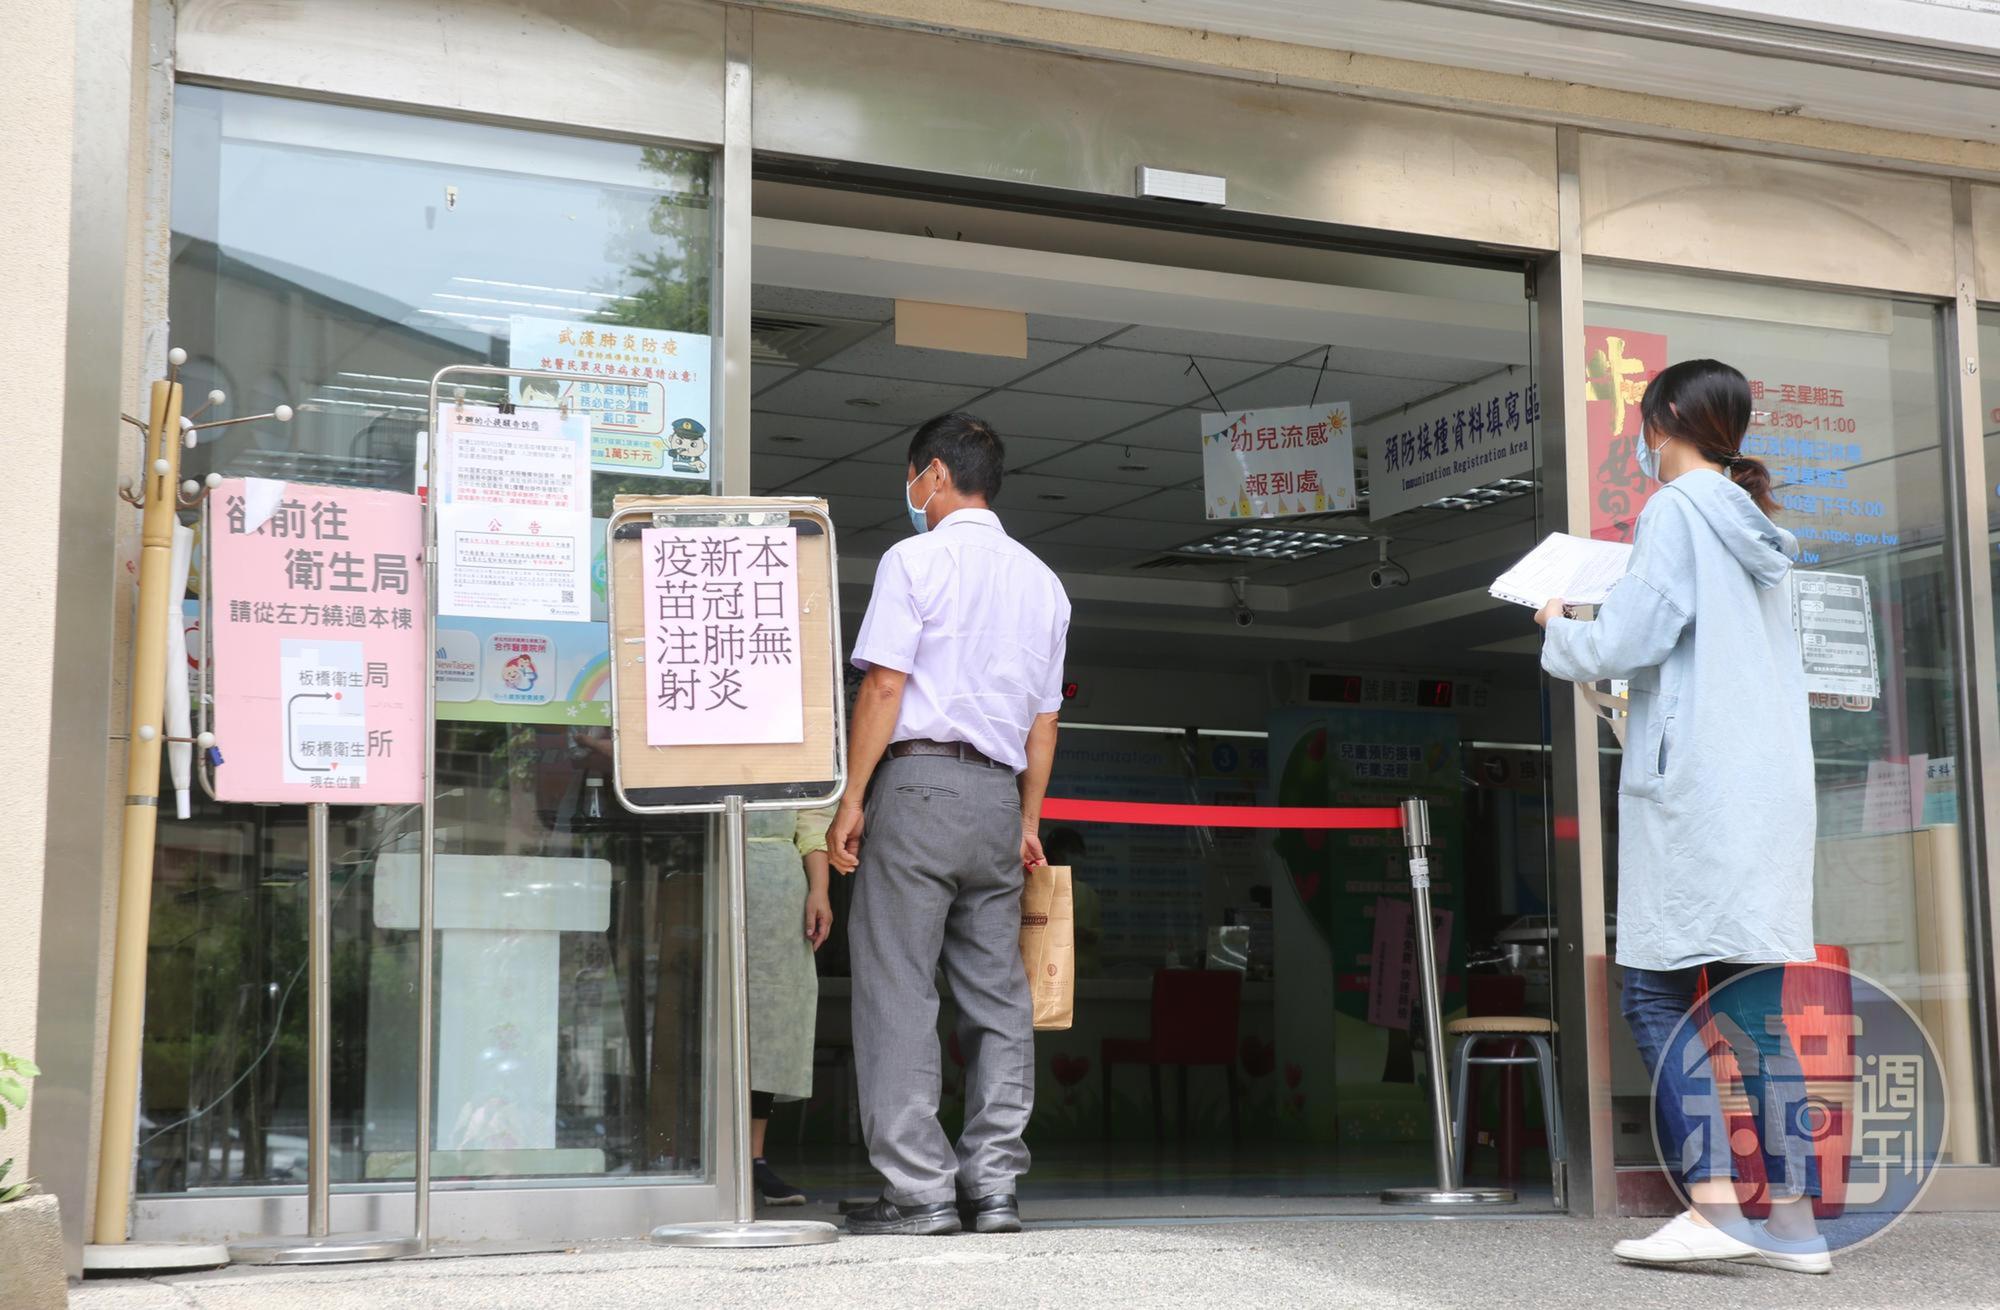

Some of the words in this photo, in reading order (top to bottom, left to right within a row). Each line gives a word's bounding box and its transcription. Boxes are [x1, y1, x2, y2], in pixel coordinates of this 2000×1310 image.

[558, 327, 679, 356] 武漢肺炎防疫
[1231, 422, 1329, 452] 幼兒流感
[1384, 383, 1541, 474] 預防接種資料填寫區
[1402, 465, 1451, 491] Immunization
[1453, 446, 1507, 474] Registration
[1509, 440, 1529, 456] Area
[1245, 469, 1320, 498] 報到處
[285, 548, 409, 596] 衛生局
[229, 599, 413, 630] 請從左方繞過本棟
[746, 535, 792, 666] 本日無
[653, 535, 701, 712] 疫苗注射
[700, 535, 748, 712] 新冠肺炎
[298, 661, 390, 689] 板橋衛生局
[300, 729, 395, 758] 板橋衛生所
[310, 775, 361, 790] 現在位置
